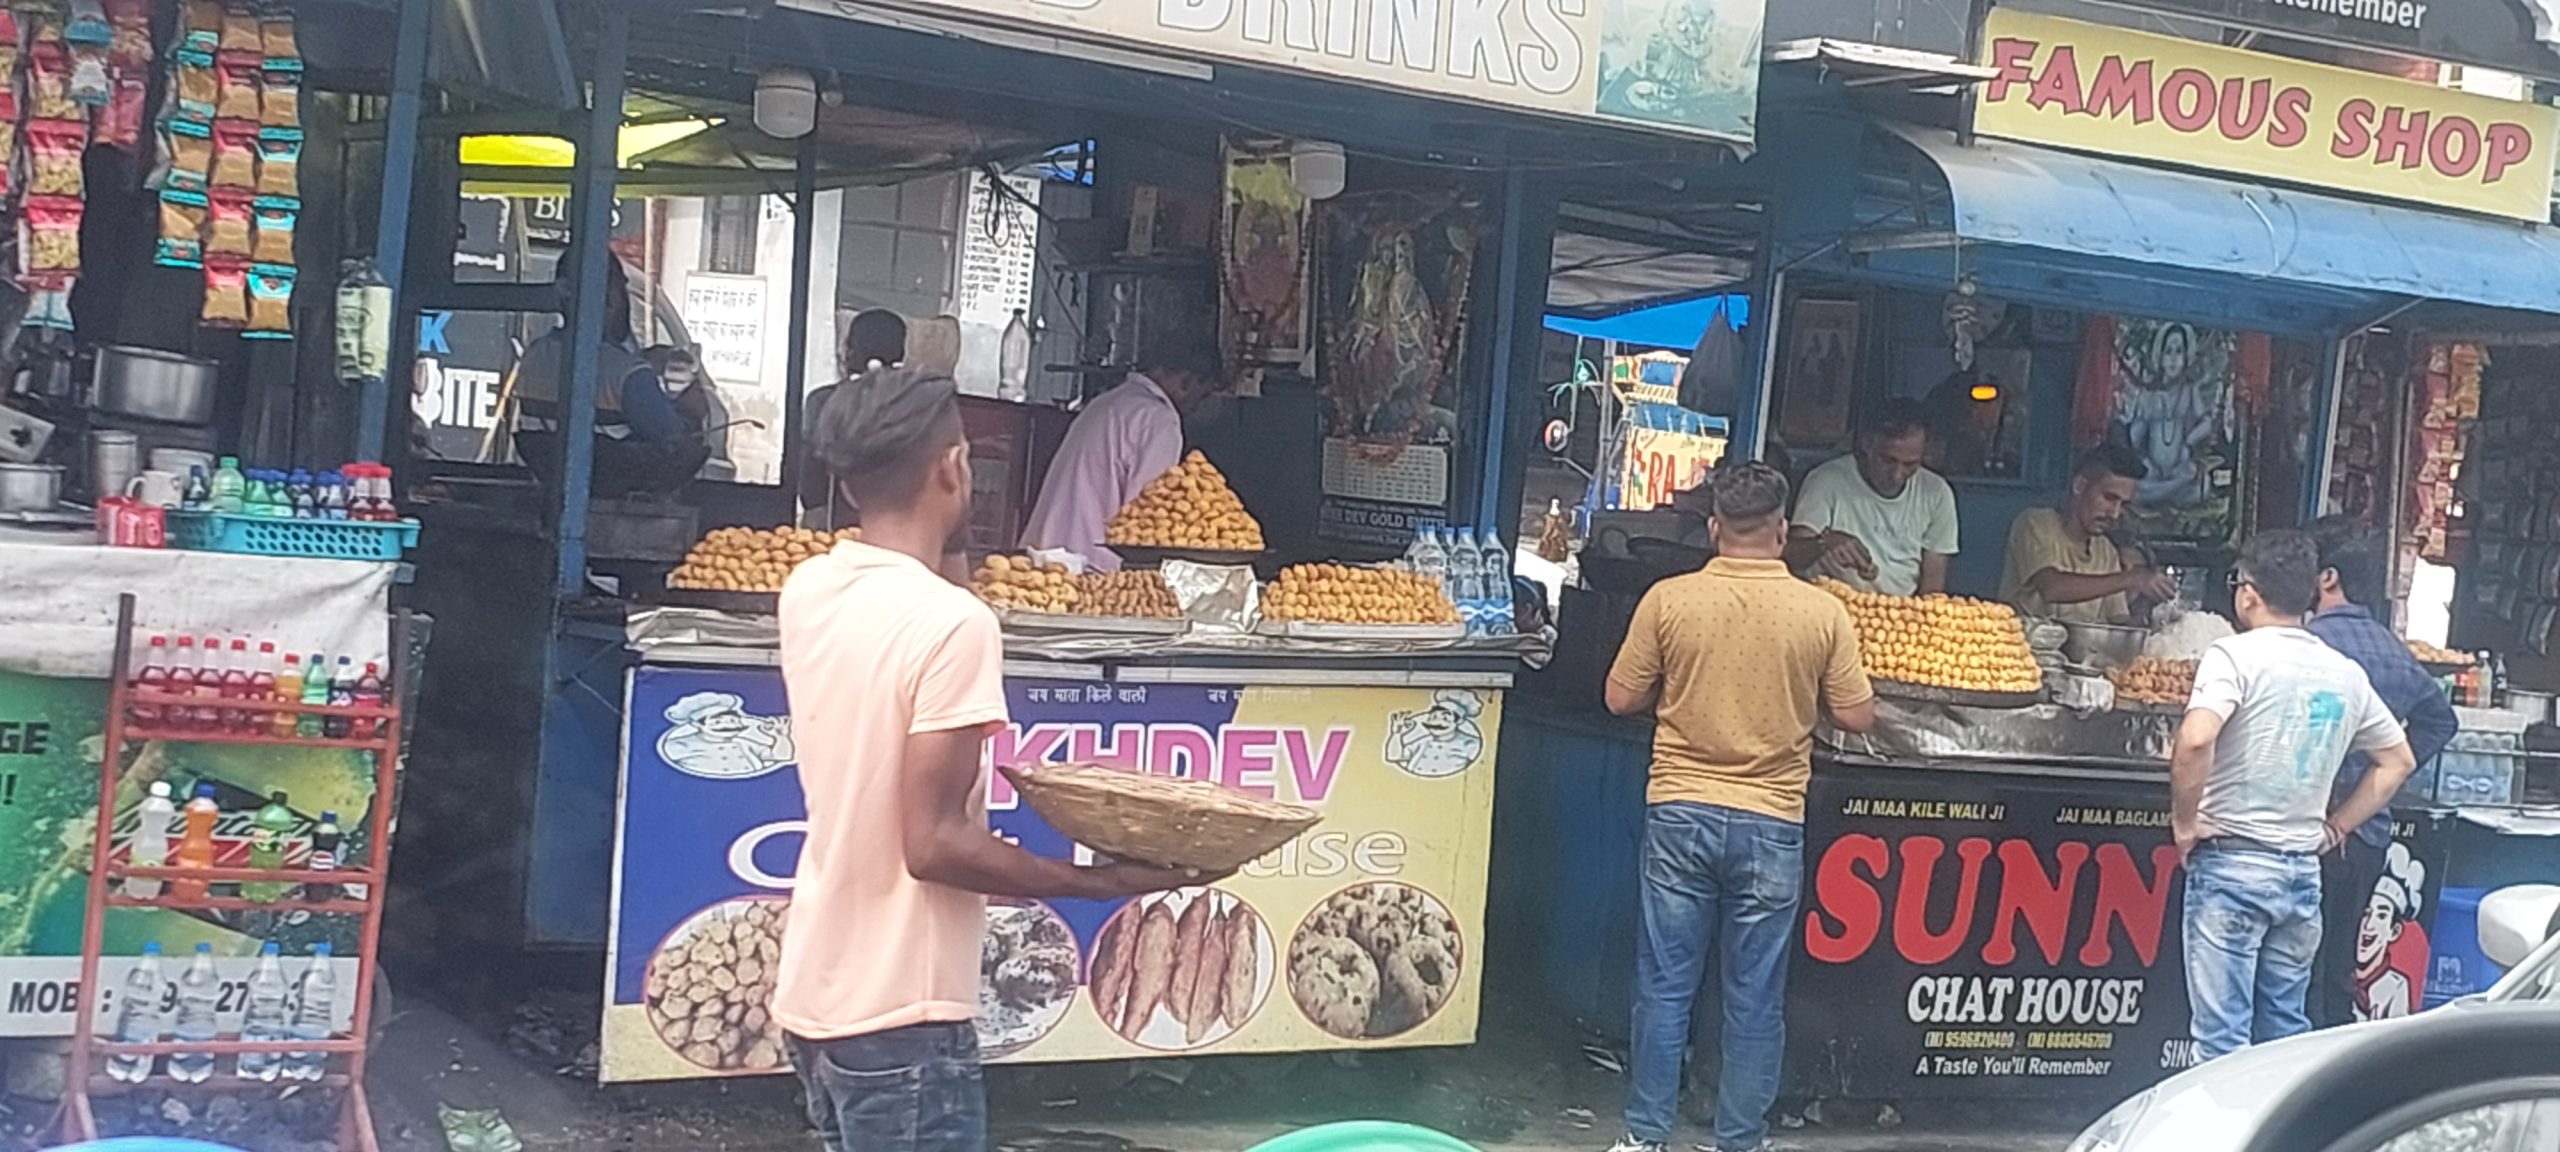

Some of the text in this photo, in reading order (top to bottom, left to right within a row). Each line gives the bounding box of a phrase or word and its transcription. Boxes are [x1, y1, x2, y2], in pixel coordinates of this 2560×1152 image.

[2275, 0, 2427, 29] member
[1157, 0, 1586, 94] INKS
[1986, 37, 2533, 184] FAMOUS SHOP
[1369, 511, 1404, 528] GOLD
[1843, 799, 2005, 821] JAI MAA KILE WALI JI
[2056, 807, 2080, 823] JAI
[2081, 808, 2112, 825] MAA
[1907, 976, 2144, 1024] CHAT HOUSE
[1916, 1056, 2112, 1076] A Taste You'll Remember
